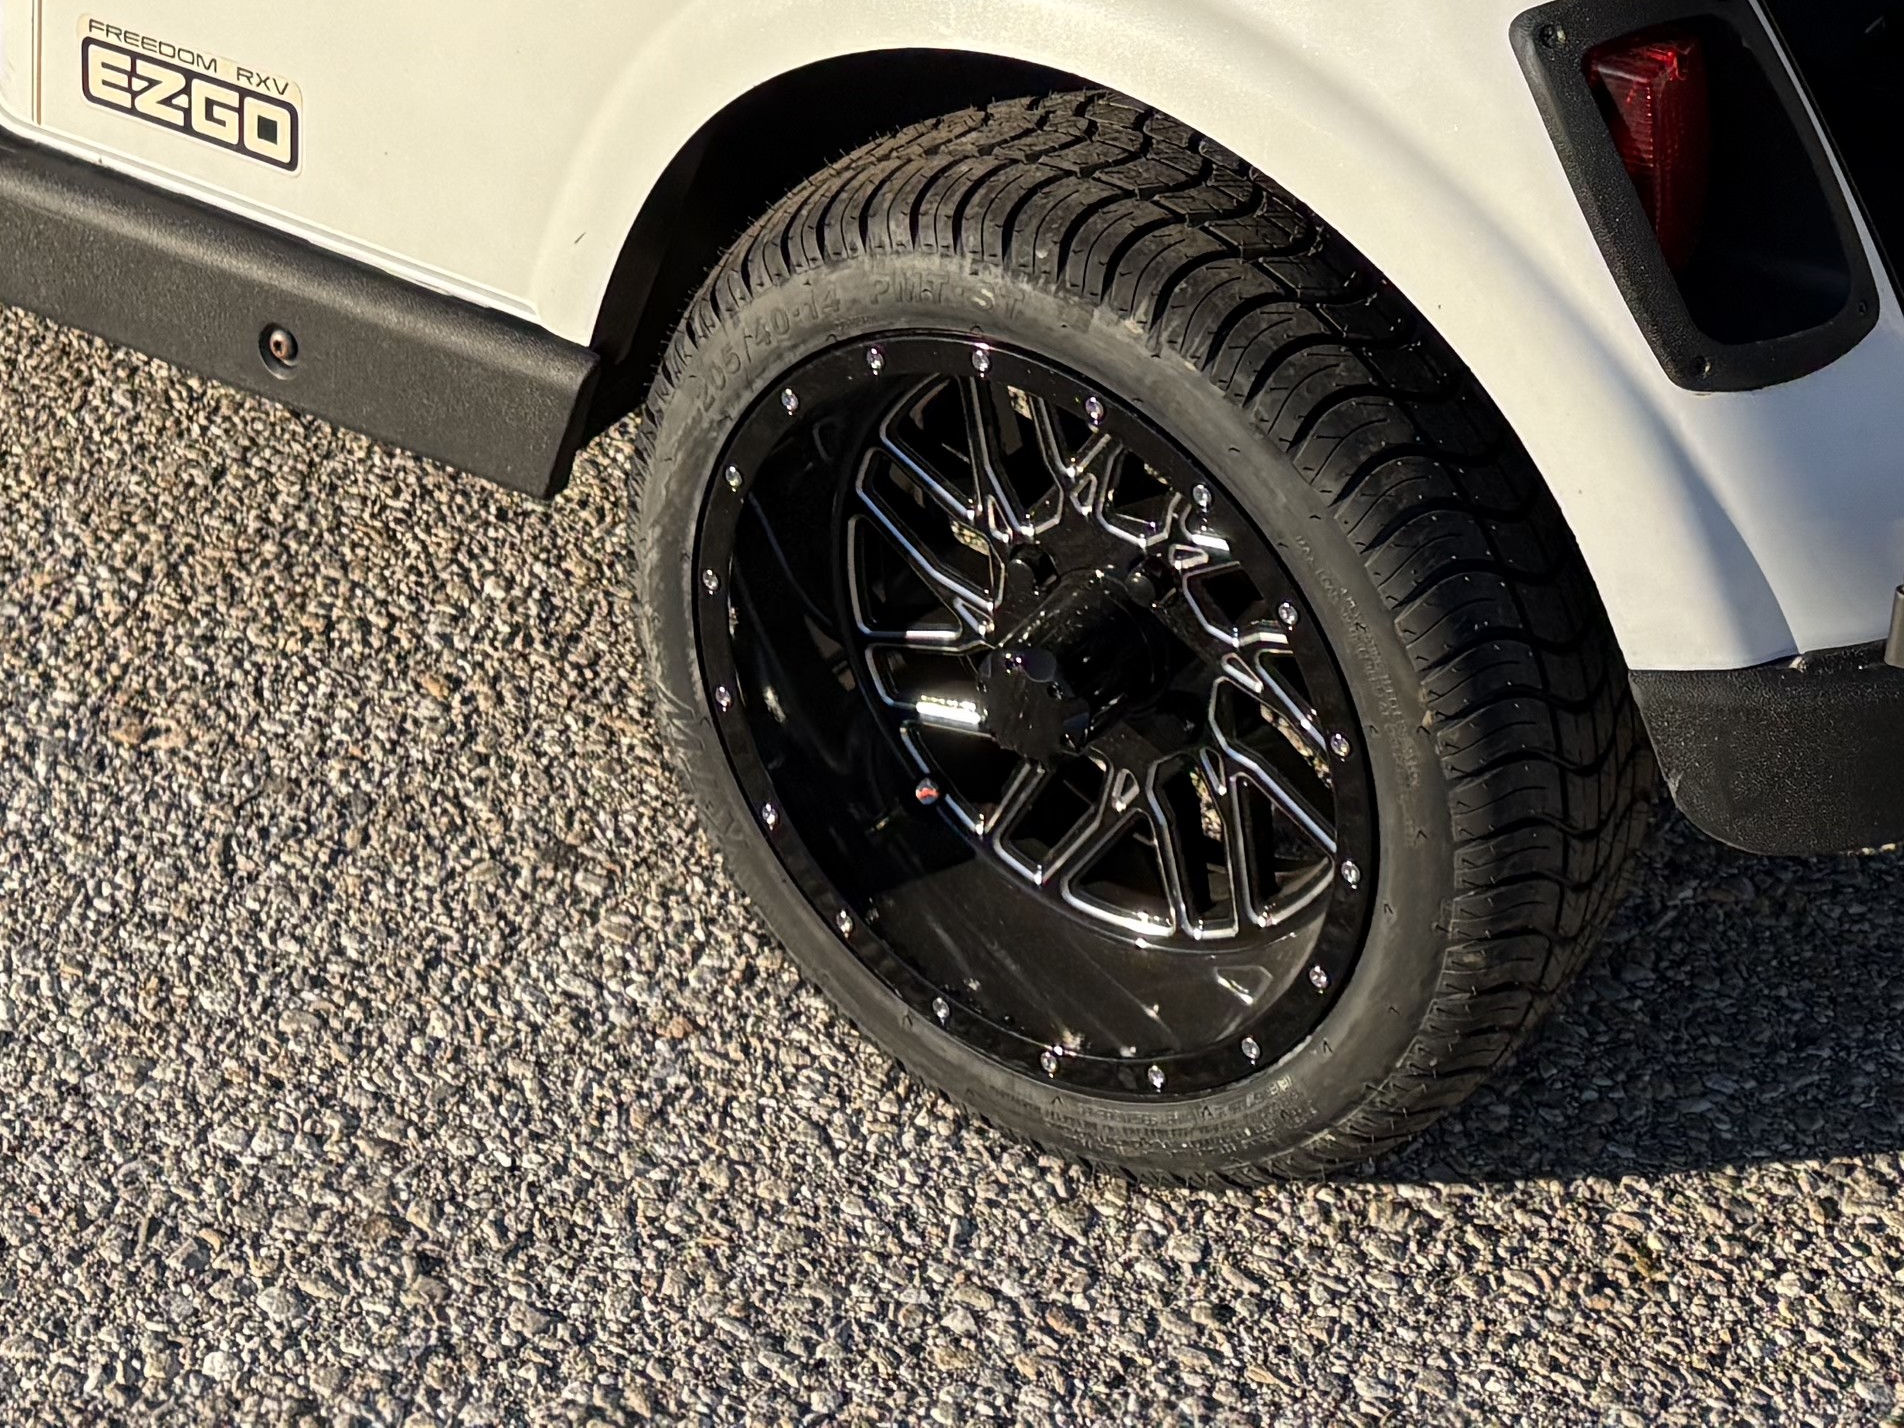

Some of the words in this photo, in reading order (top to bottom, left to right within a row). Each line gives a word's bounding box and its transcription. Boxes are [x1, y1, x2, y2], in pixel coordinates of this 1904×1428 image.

[86, 41, 294, 165] EZGO
[88, 17, 218, 74] FREEDOM
[235, 65, 289, 96] RXV
